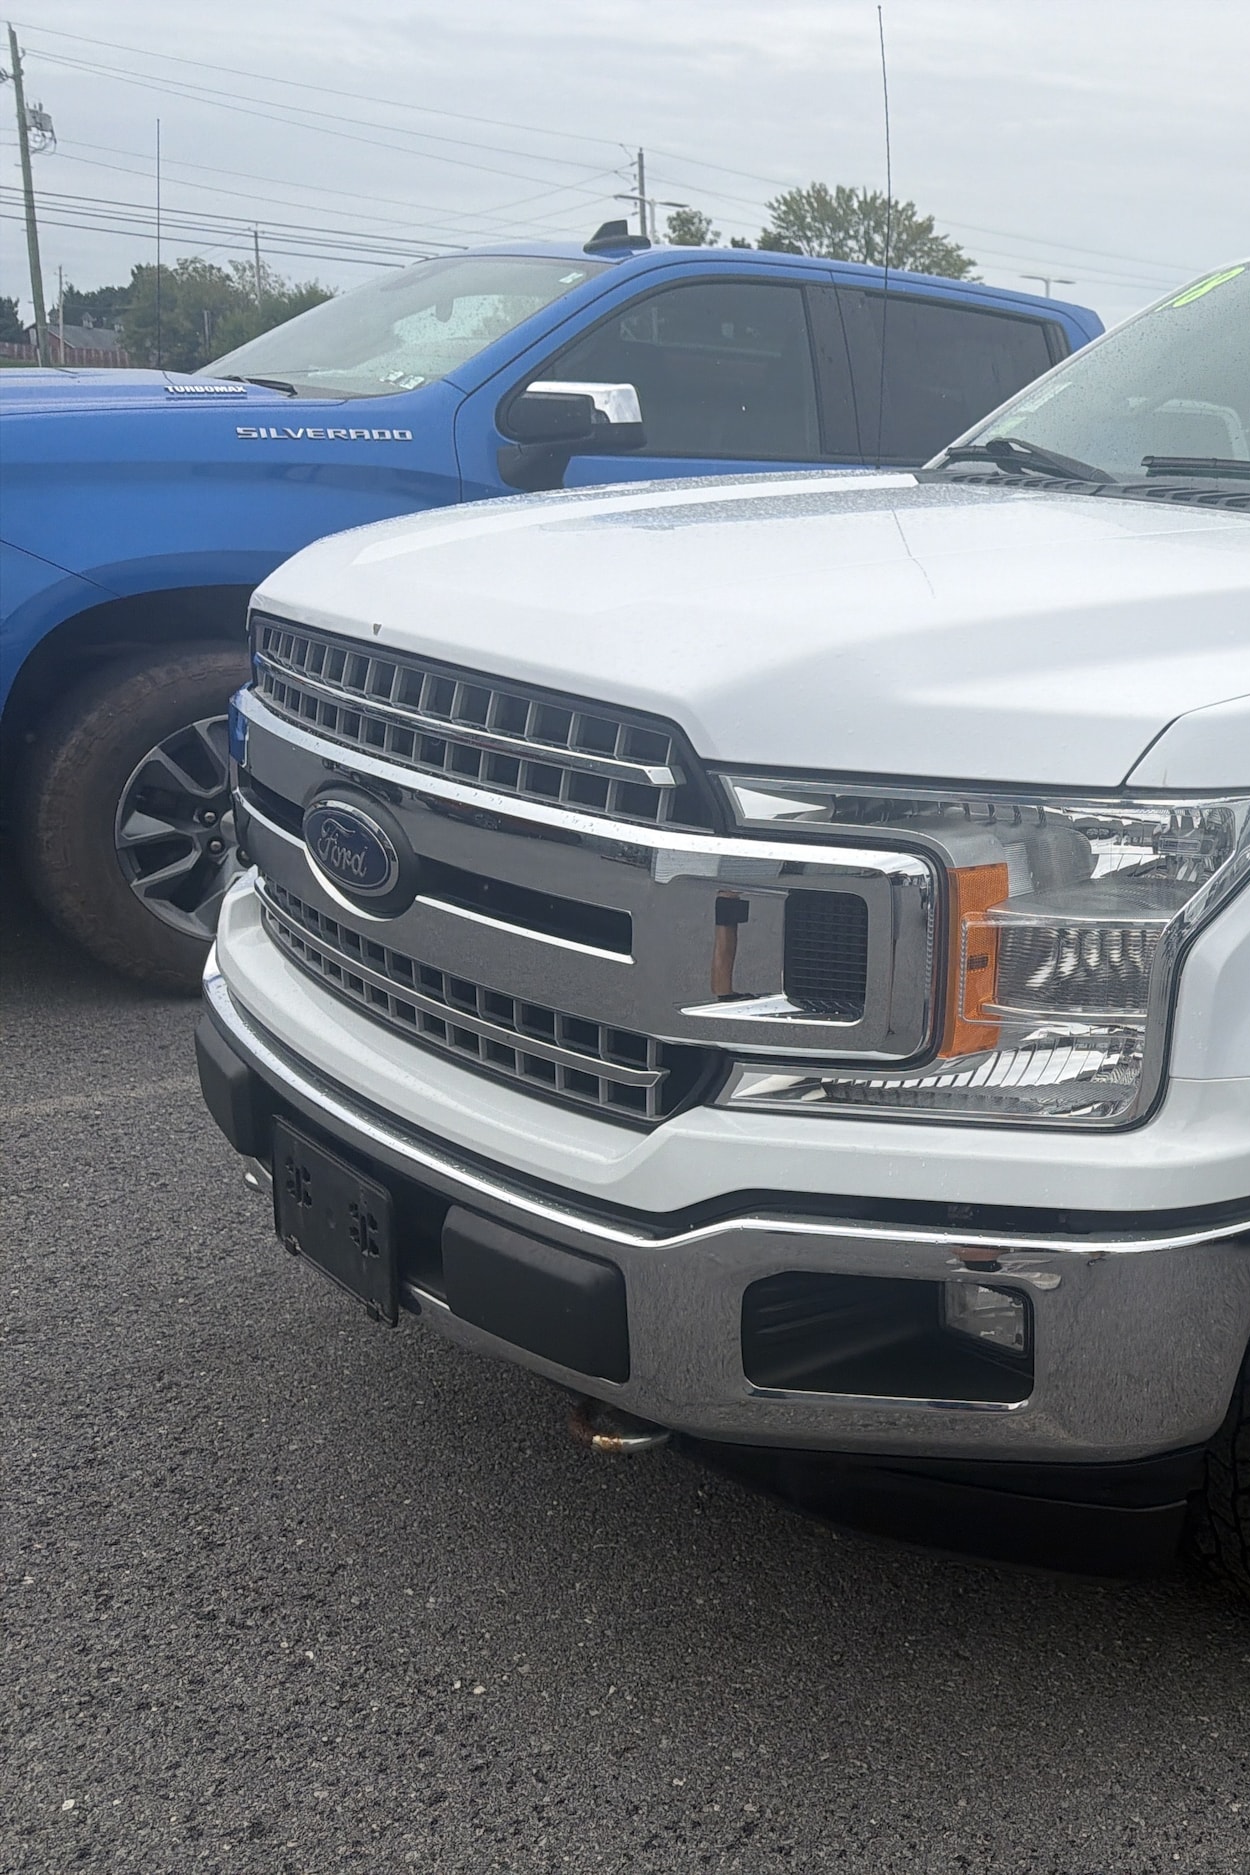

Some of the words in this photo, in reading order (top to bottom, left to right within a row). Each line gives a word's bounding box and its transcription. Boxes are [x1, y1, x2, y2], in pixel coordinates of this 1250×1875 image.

[165, 385, 247, 395] TURBOMAX
[236, 426, 413, 441] SILVERADO
[317, 817, 368, 878] Ford
